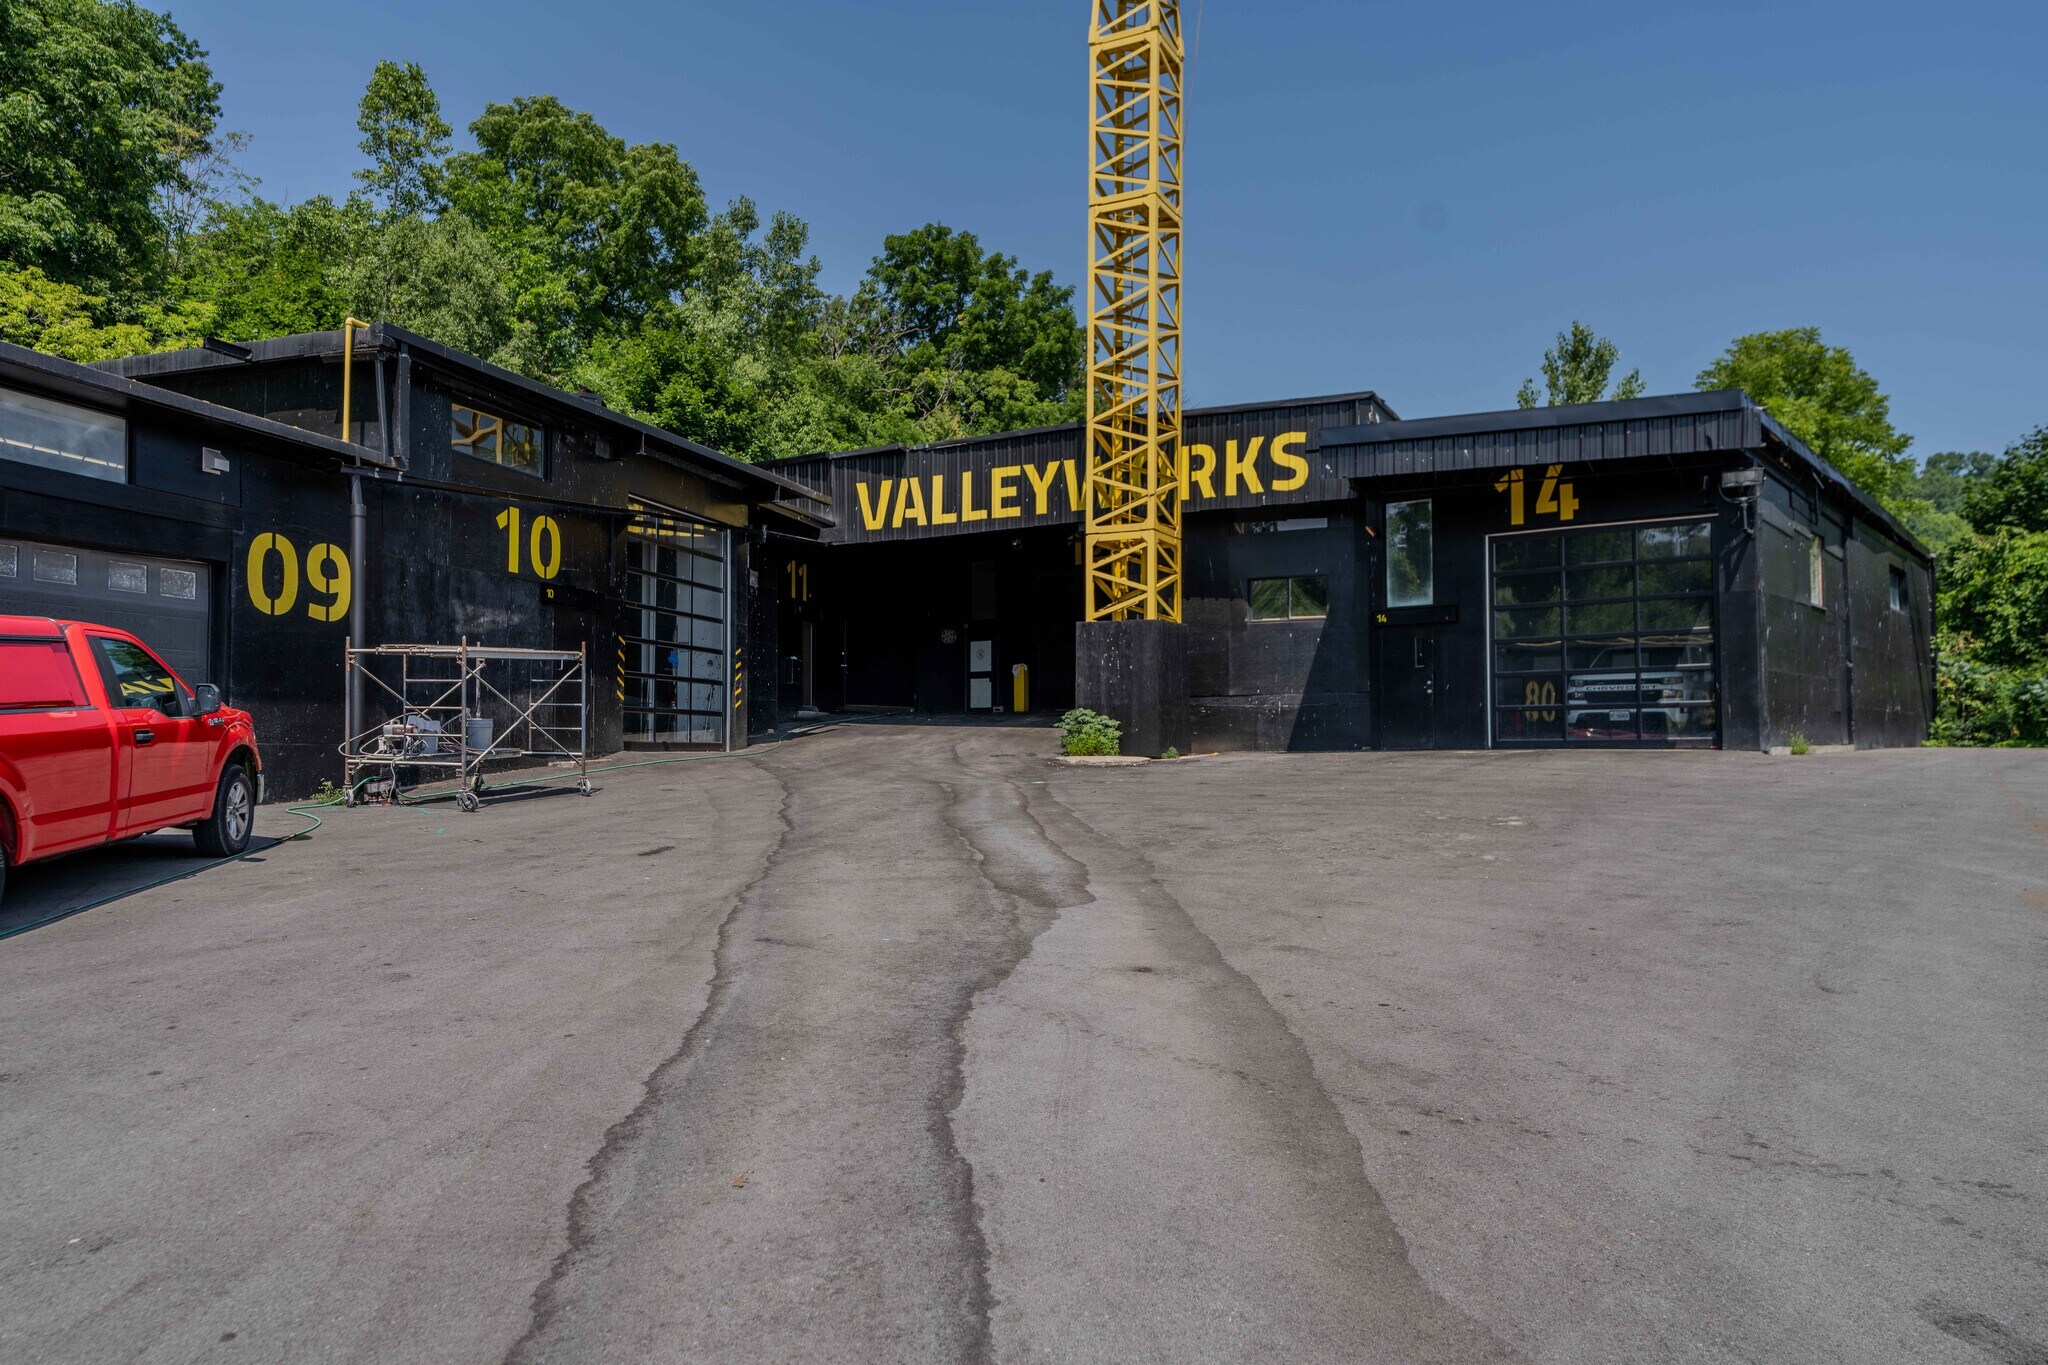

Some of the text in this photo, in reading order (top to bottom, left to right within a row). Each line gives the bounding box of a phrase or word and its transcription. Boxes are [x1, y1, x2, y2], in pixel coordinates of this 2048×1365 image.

[1494, 464, 1579, 526] 14
[495, 506, 561, 580] 10
[246, 532, 352, 622] 09
[546, 588, 555, 599] 10
[786, 560, 807, 602] 11
[1376, 613, 1388, 624] 14
